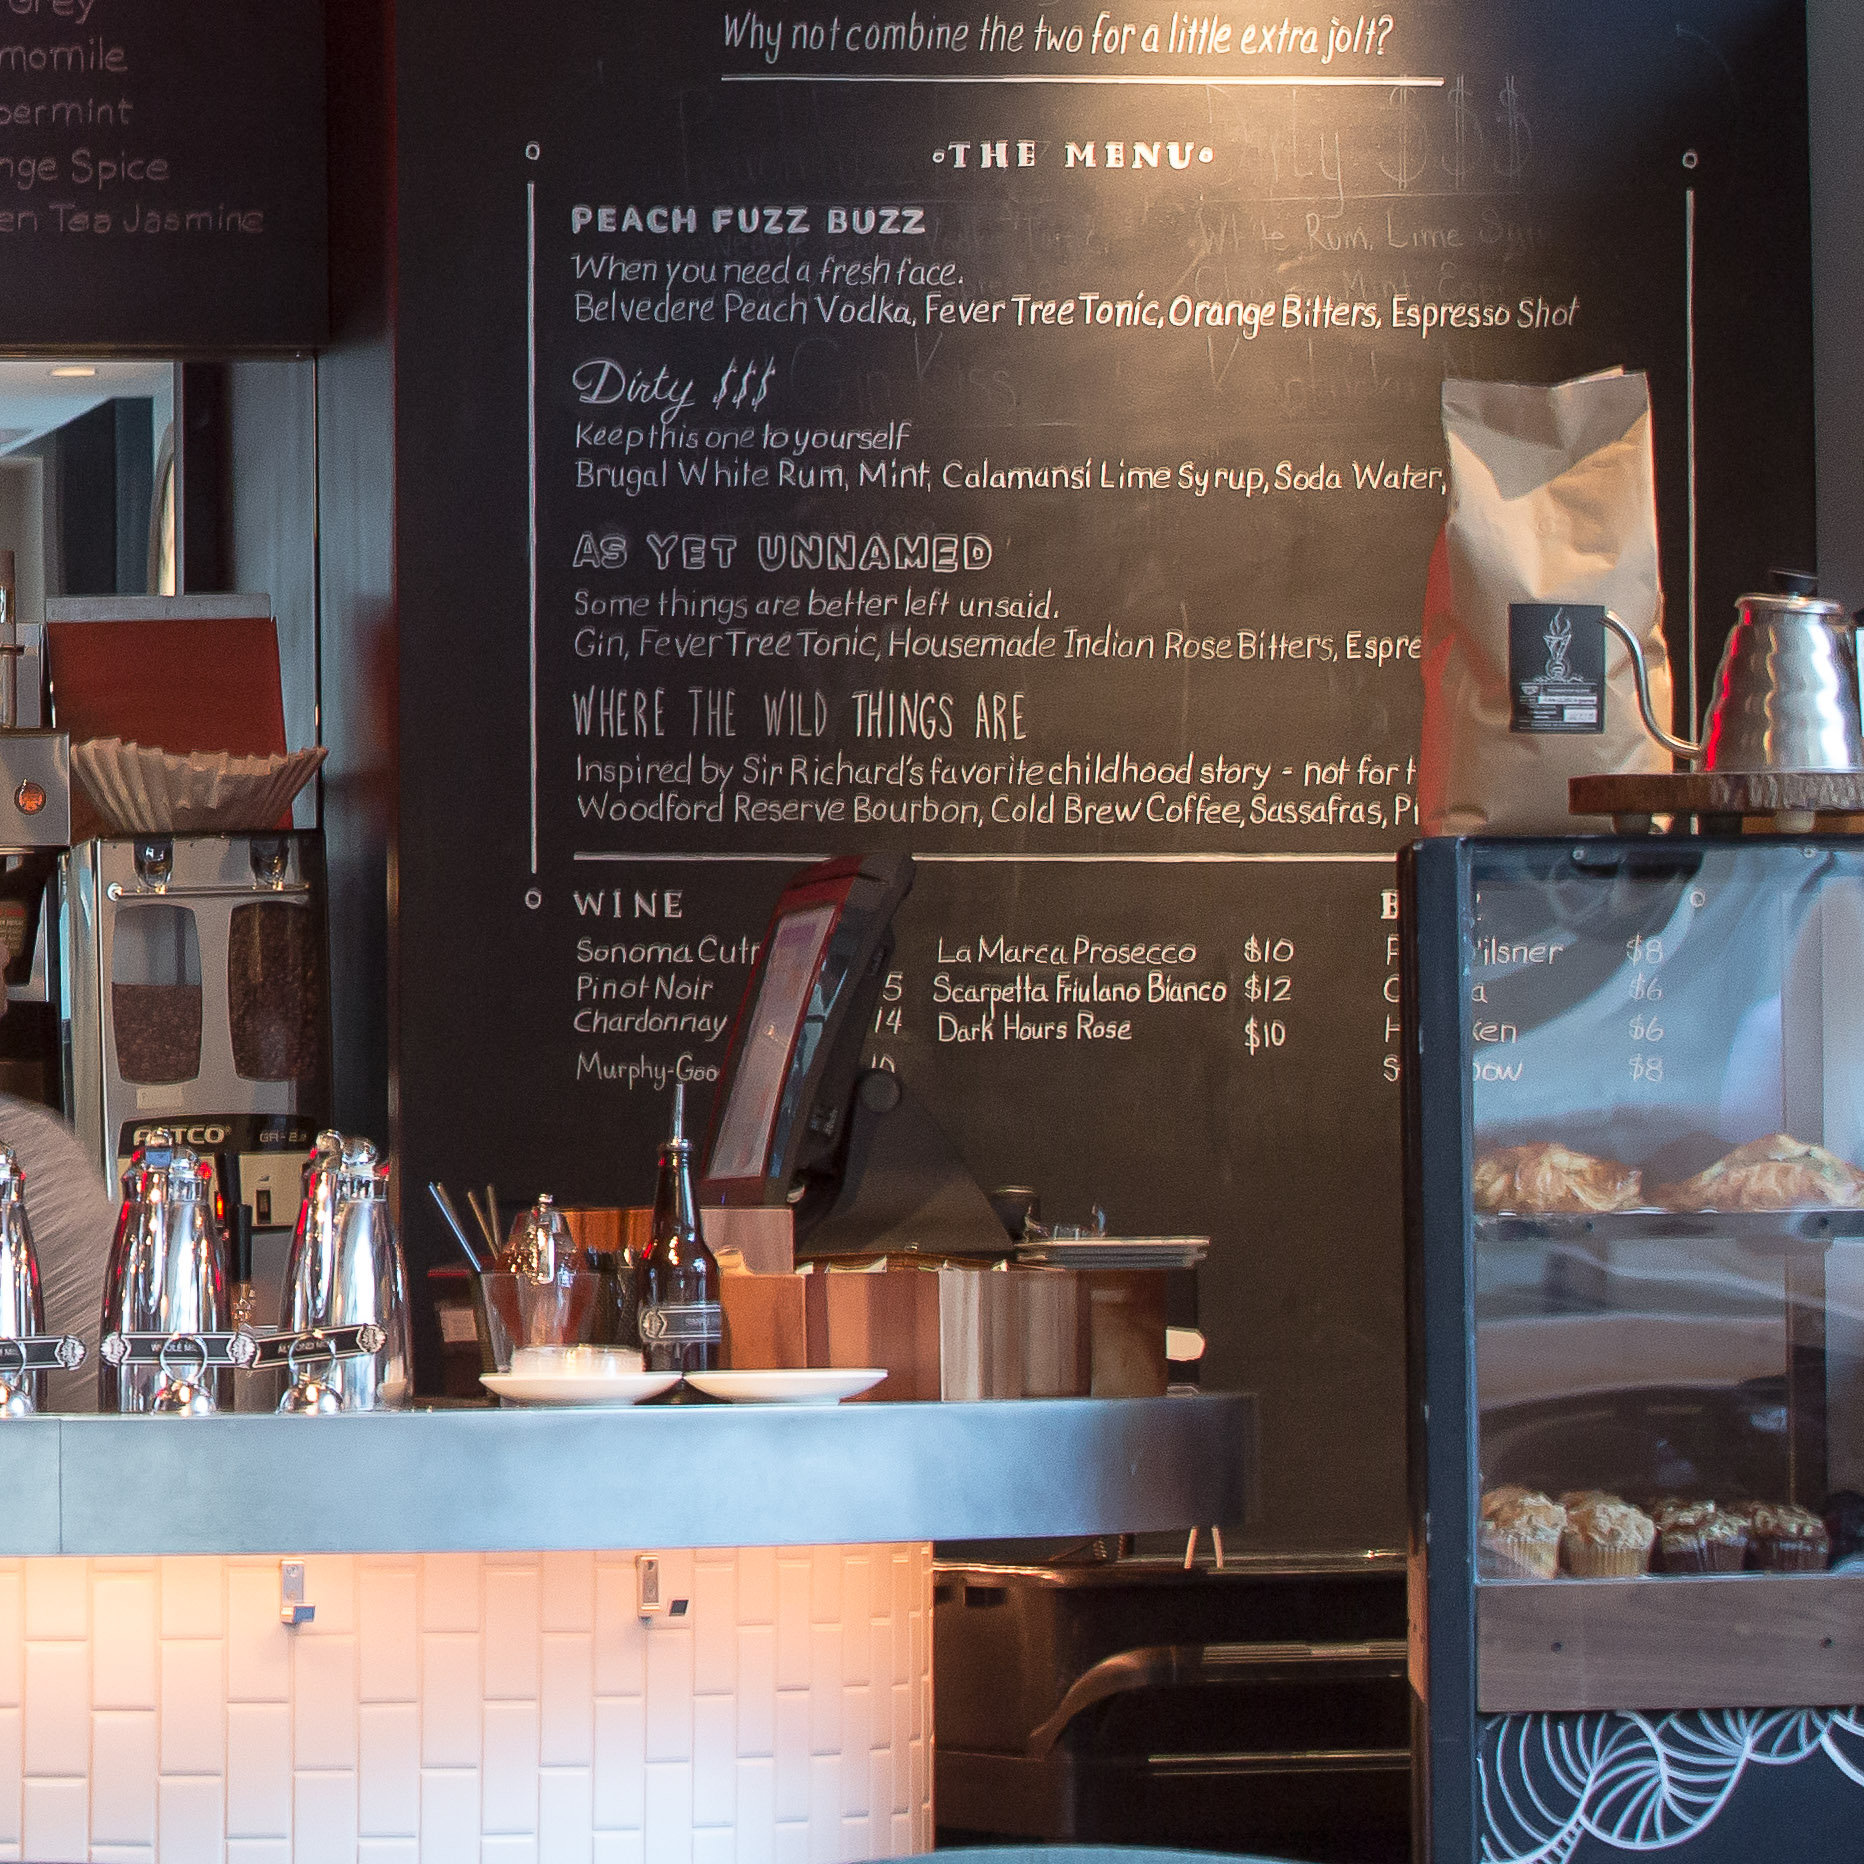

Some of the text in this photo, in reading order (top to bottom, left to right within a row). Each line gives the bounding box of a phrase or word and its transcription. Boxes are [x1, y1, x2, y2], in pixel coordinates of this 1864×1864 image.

[71, 147, 169, 190] Spice
[948, 141, 1193, 168] THE MENU
[49, 203, 111, 234] Tea
[572, 206, 925, 234] PEACH FUZZ BUZZ
[575, 291, 1580, 339] Belvedere Peach Vodka, Fever Tree Tonic, Orange Bitters, Espresso Shot
[572, 532, 993, 573] AS YET UNNAMED
[572, 685, 1026, 741] WHERE THE WILD THINGS ARE
[577, 791, 1387, 828] Woodford Reserve Bourbon, Cold Brew Coffee, Sassafras,
[573, 890, 682, 918] WINE
[577, 974, 713, 1001] Pinot Noir
[933, 972, 1291, 1023] Scarpetta Friulano Bianco $12
[573, 1008, 728, 1041] Chardonnay
[939, 1009, 1286, 1055] Dark Hours Rose $10
